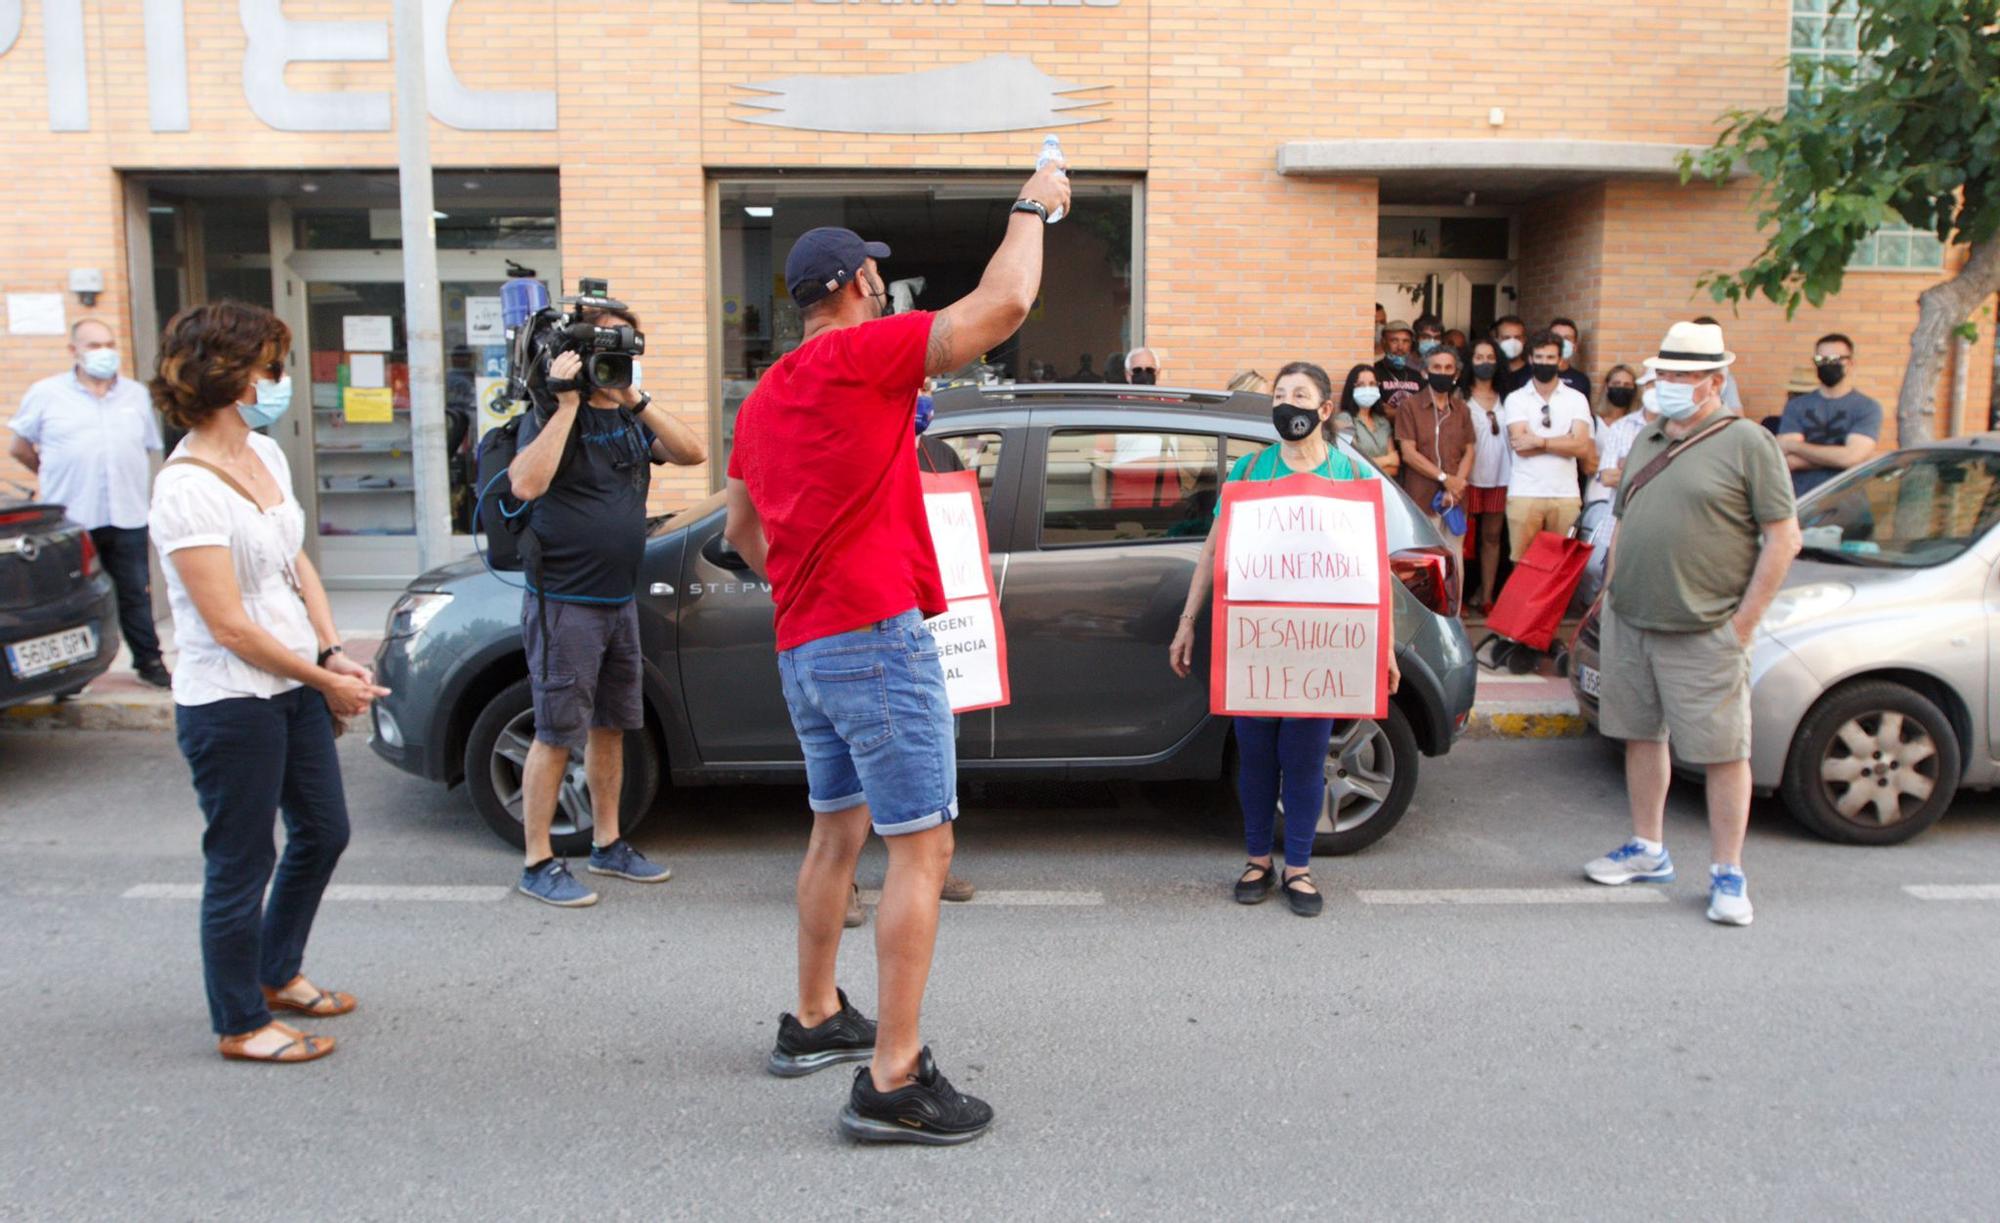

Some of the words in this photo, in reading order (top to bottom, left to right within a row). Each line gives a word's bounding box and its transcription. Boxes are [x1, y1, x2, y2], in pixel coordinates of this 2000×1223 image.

[1412, 228, 1427, 247] 14
[1235, 550, 1368, 581] VULNERABLE
[927, 615, 974, 632] RGENT
[19, 639, 61, 667] 5606
[1246, 664, 1361, 700] ILEGAL
